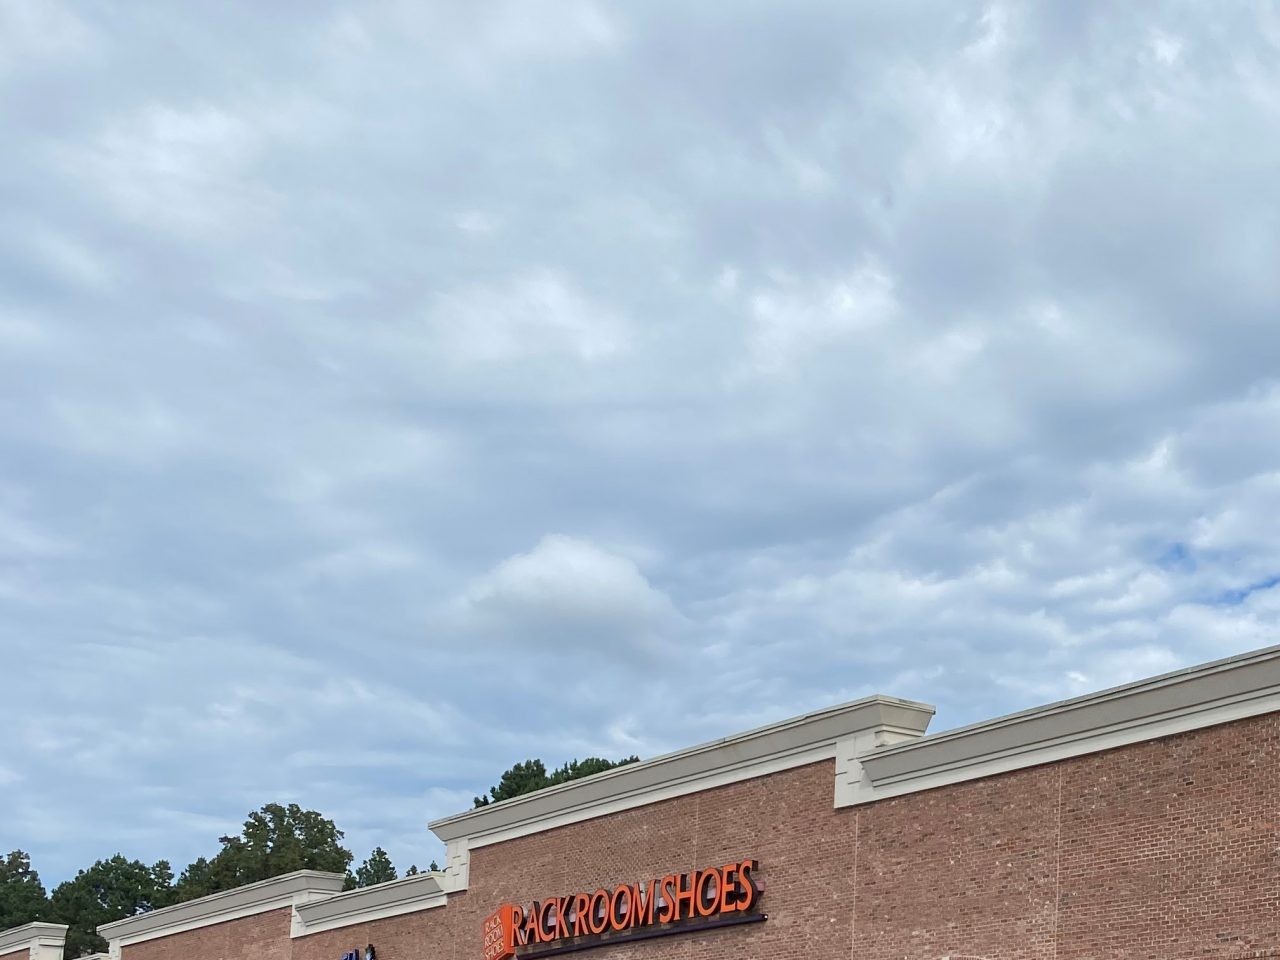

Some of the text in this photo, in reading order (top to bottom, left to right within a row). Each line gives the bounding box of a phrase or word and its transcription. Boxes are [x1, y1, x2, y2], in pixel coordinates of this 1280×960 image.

[511, 860, 756, 946] RACK ROOM SHOES
